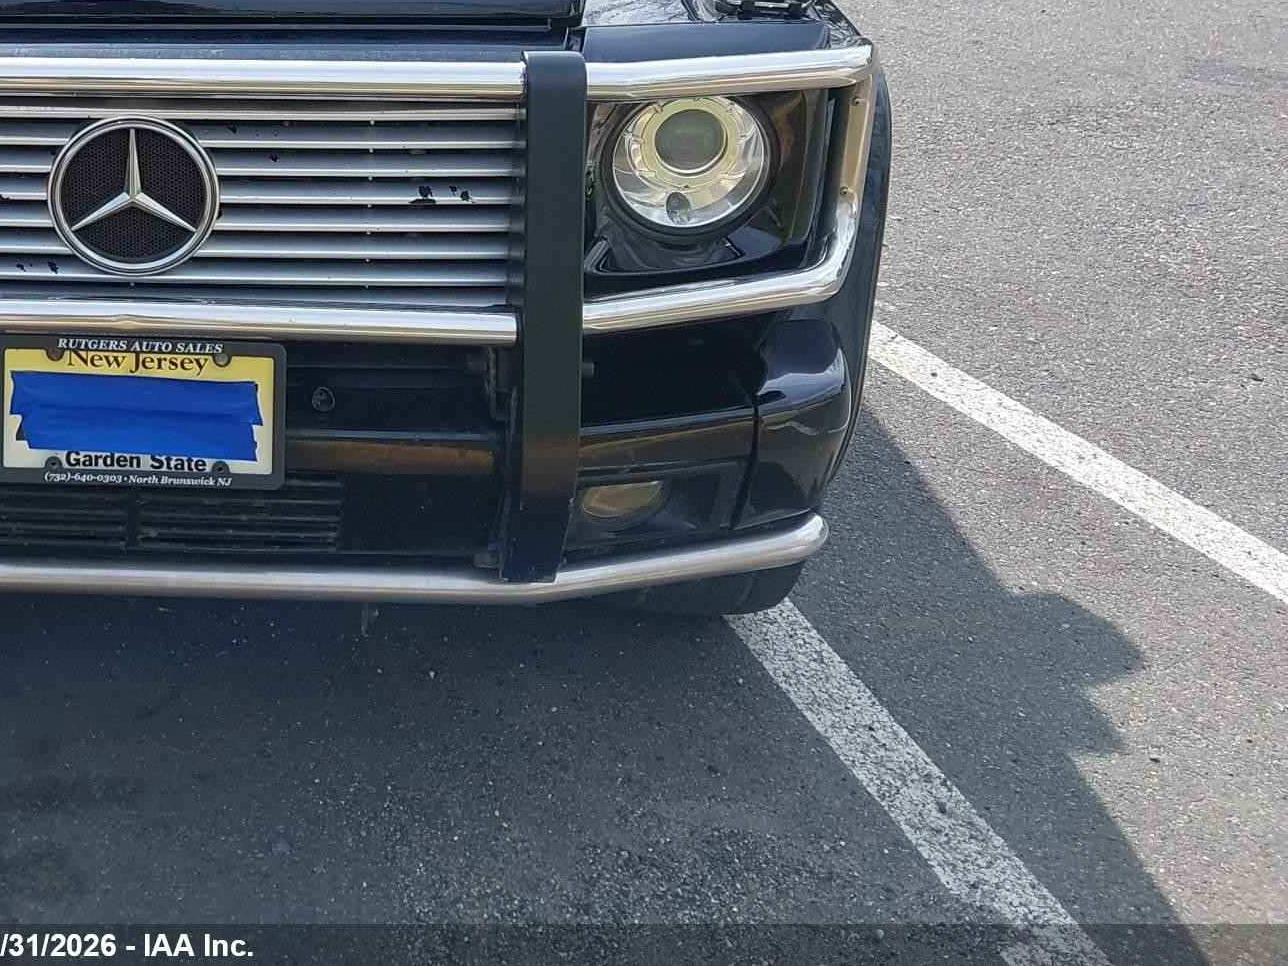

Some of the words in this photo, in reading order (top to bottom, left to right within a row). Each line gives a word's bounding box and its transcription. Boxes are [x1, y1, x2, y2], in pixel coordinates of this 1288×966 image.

[57, 338, 128, 351] RUTGERS
[130, 340, 172, 352] AUTO
[175, 342, 223, 354] SALES
[67, 350, 127, 368] New
[129, 353, 208, 376] Jersey
[65, 450, 141, 468] Garden
[150, 455, 207, 472] State
[128, 475, 158, 485] North
[160, 476, 215, 487] Brunswick
[216, 478, 232, 487] NJ
